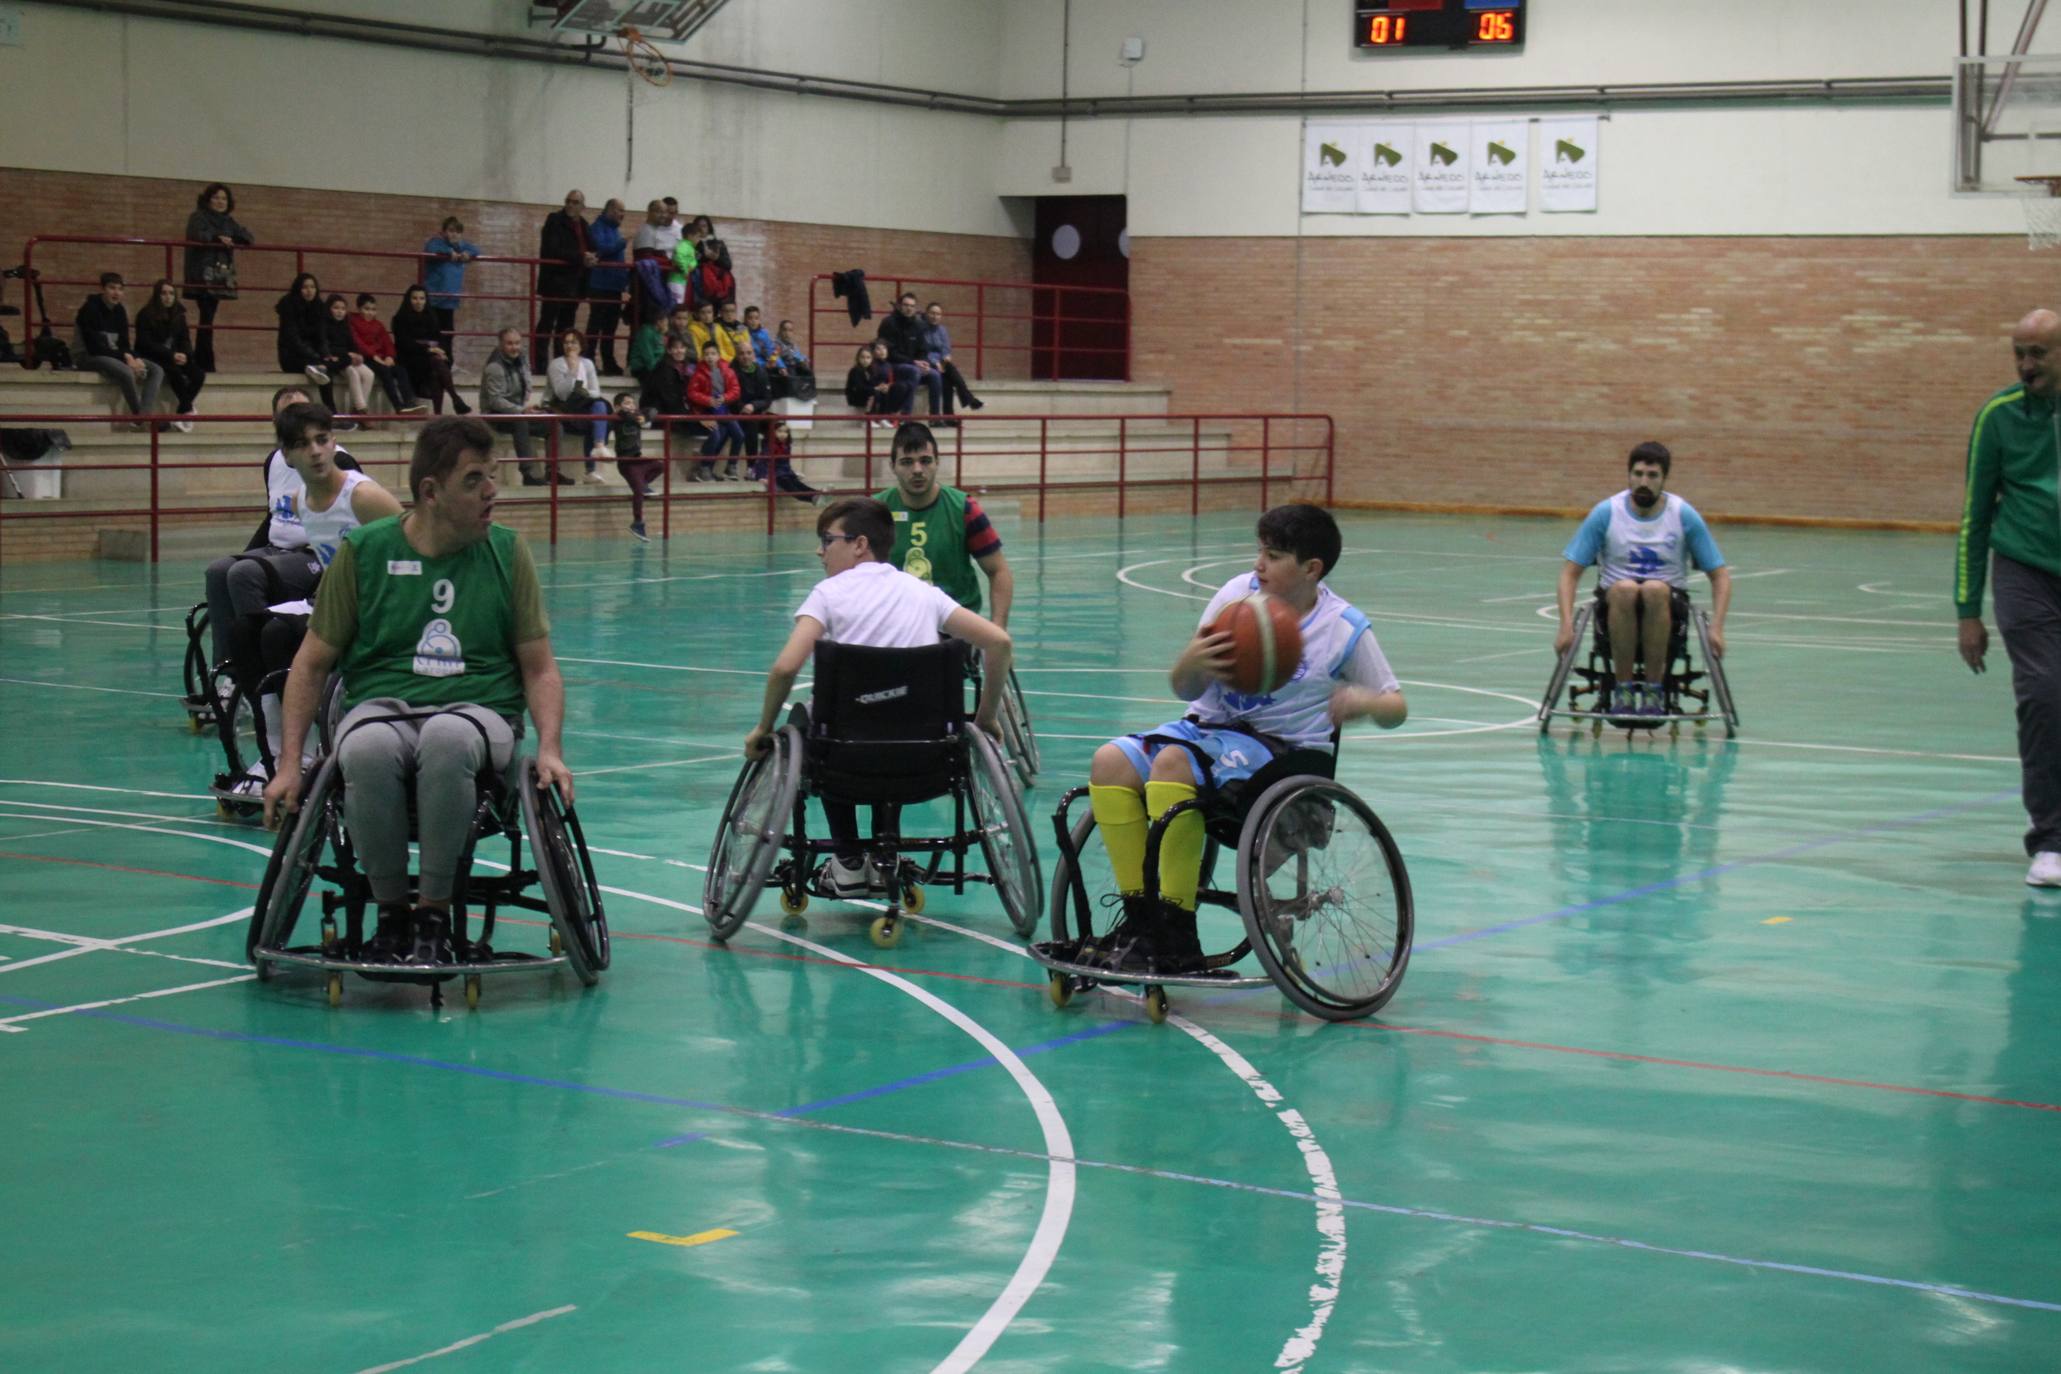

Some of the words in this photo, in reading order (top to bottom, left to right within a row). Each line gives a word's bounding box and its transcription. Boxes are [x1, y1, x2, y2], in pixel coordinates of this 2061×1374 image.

[1370, 15, 1406, 43] 01
[910, 521, 928, 546] 5
[431, 579, 455, 614] 9
